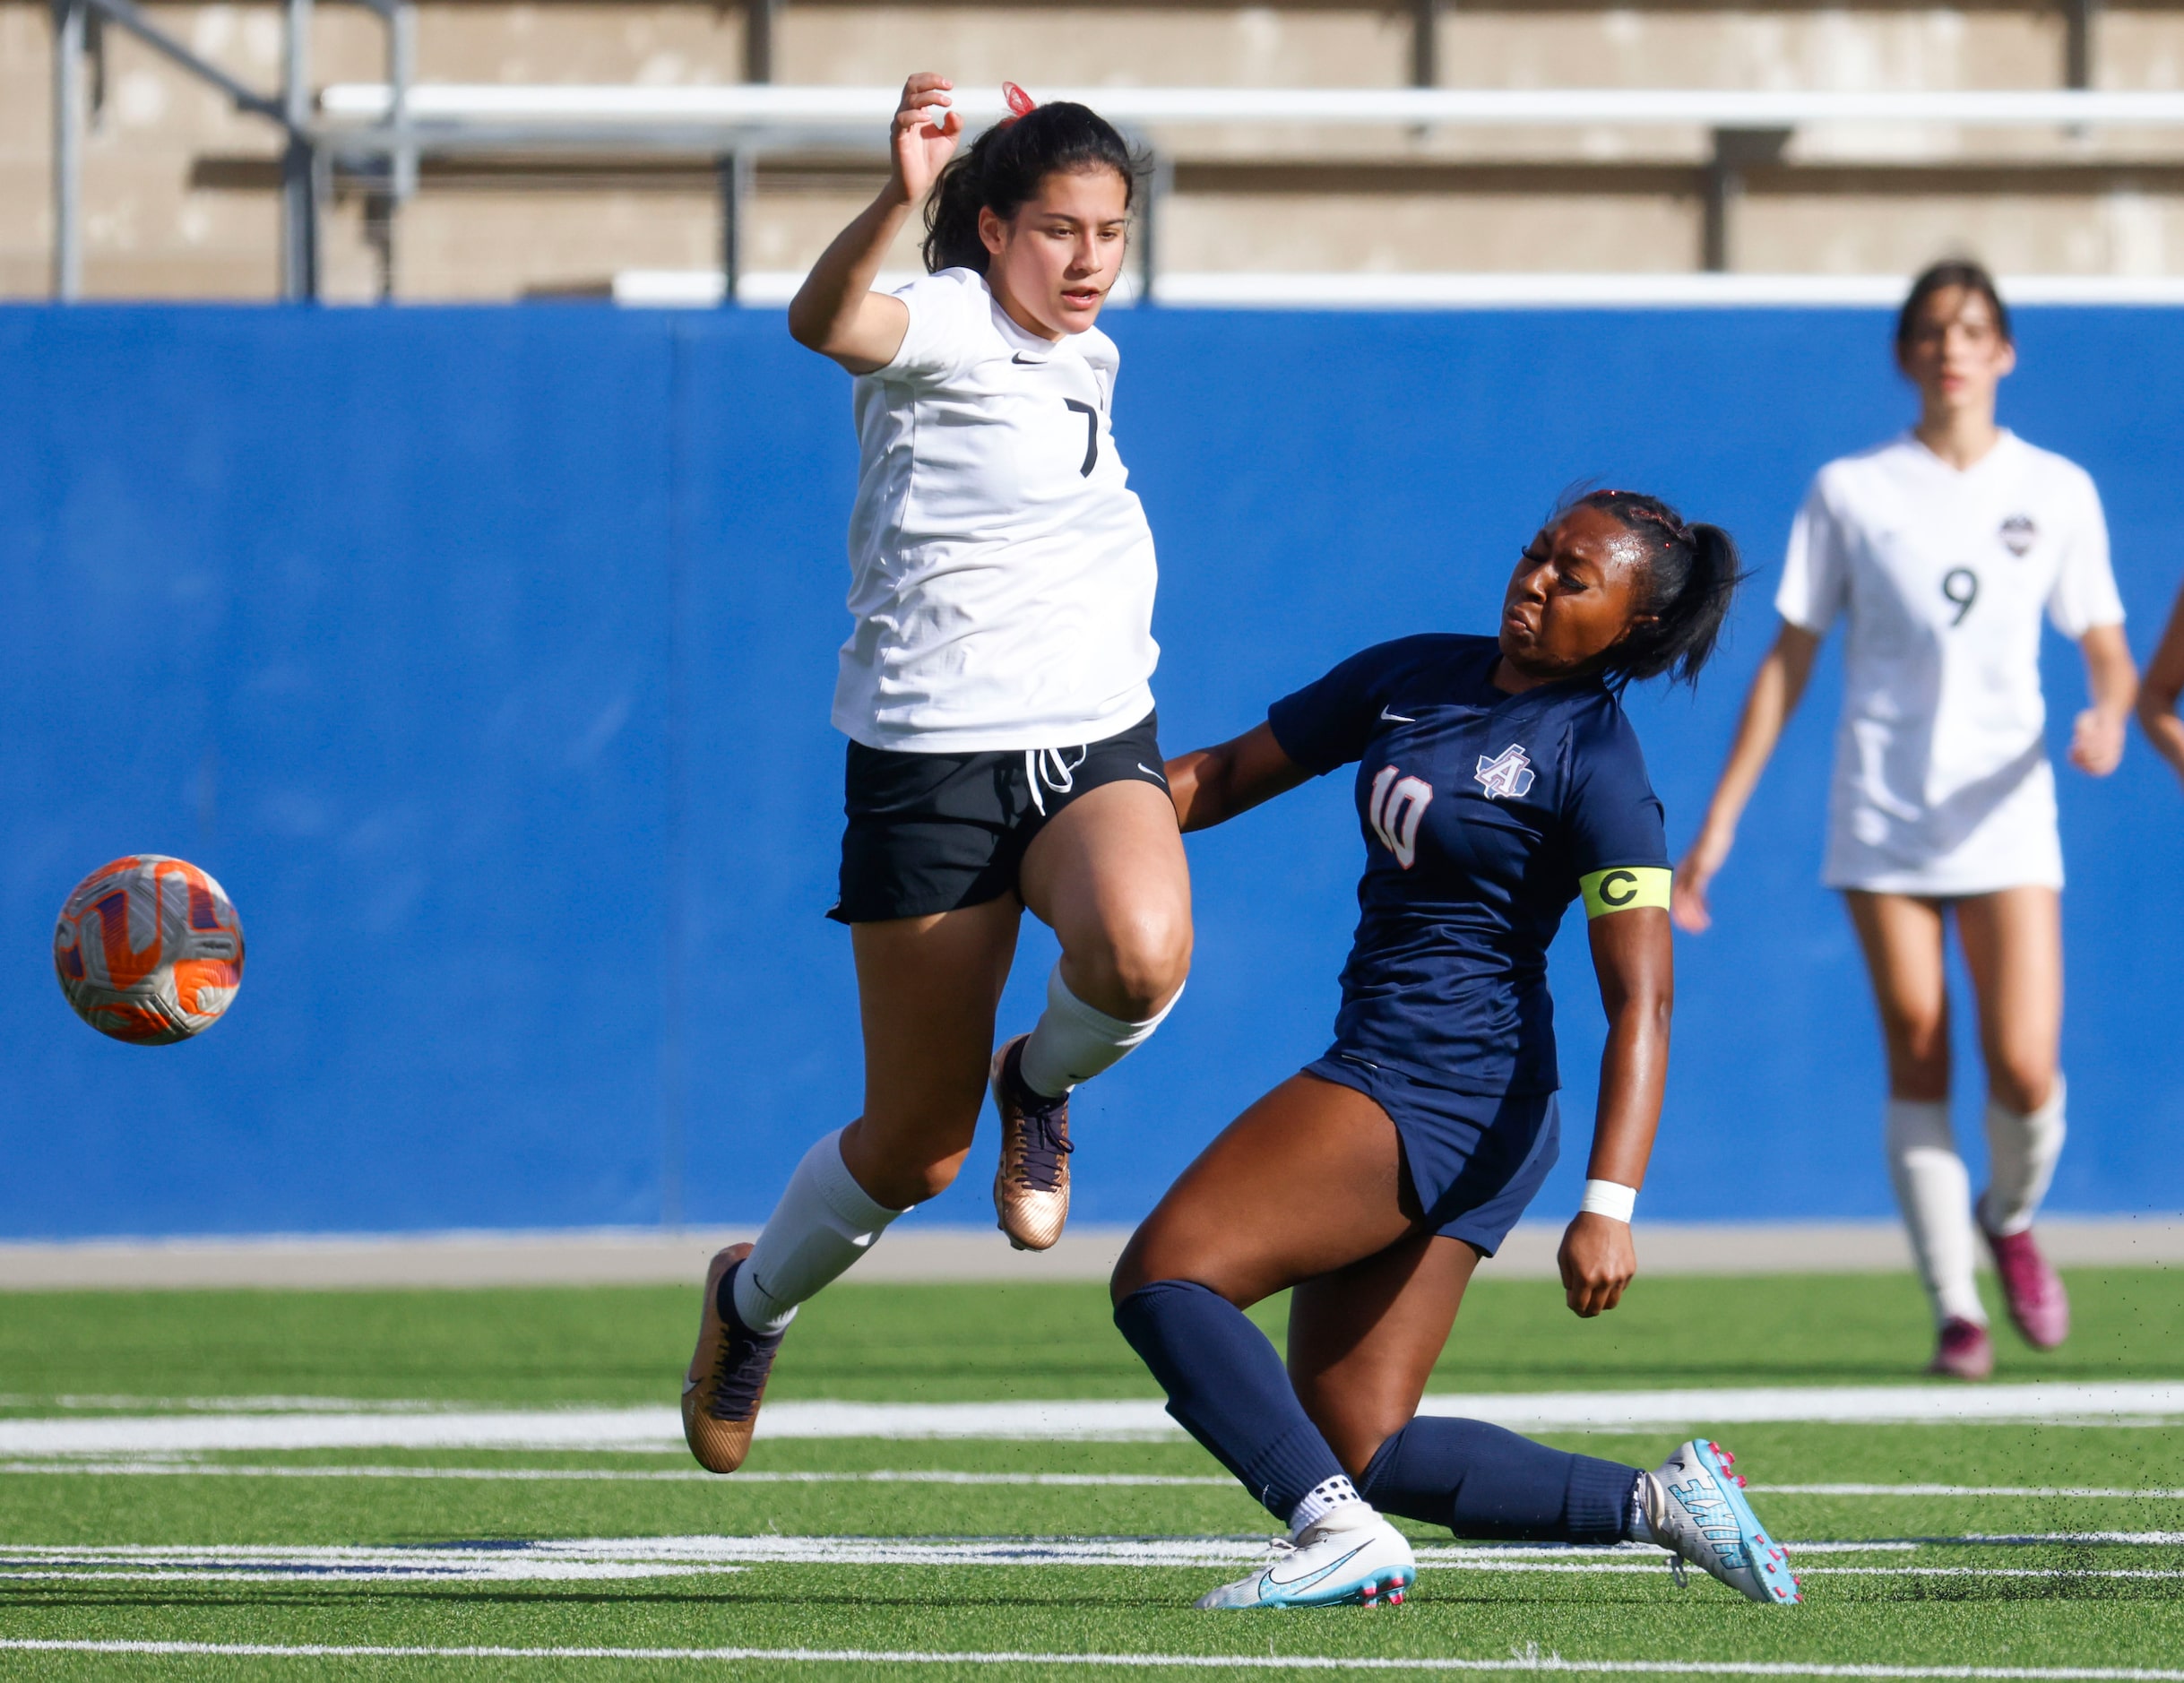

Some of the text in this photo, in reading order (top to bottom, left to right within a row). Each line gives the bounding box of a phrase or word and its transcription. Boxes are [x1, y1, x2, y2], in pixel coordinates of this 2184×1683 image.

[1062, 397, 1099, 479] 7
[1942, 565, 1979, 628] 9
[1368, 764, 1433, 870] 10
[1599, 870, 1638, 906] C
[1668, 1475, 1752, 1570] NIKE
